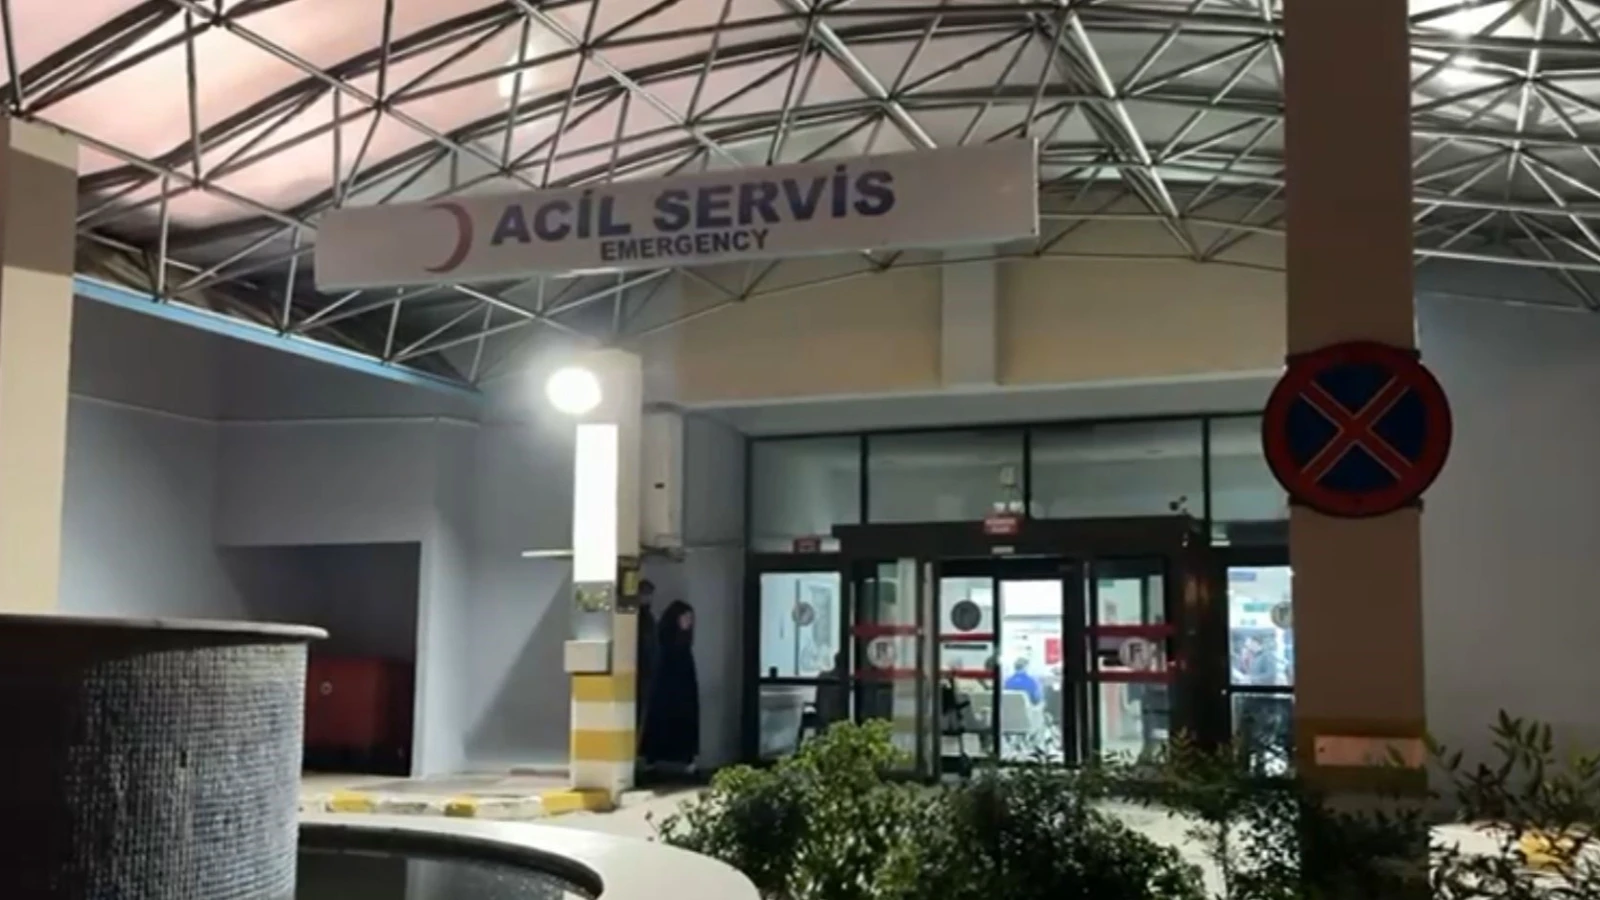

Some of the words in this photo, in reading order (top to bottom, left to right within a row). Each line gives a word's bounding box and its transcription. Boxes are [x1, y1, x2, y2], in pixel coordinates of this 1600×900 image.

[490, 189, 632, 246] ACİL
[652, 164, 896, 232] SERVİS
[601, 228, 769, 262] EMERGENCY
